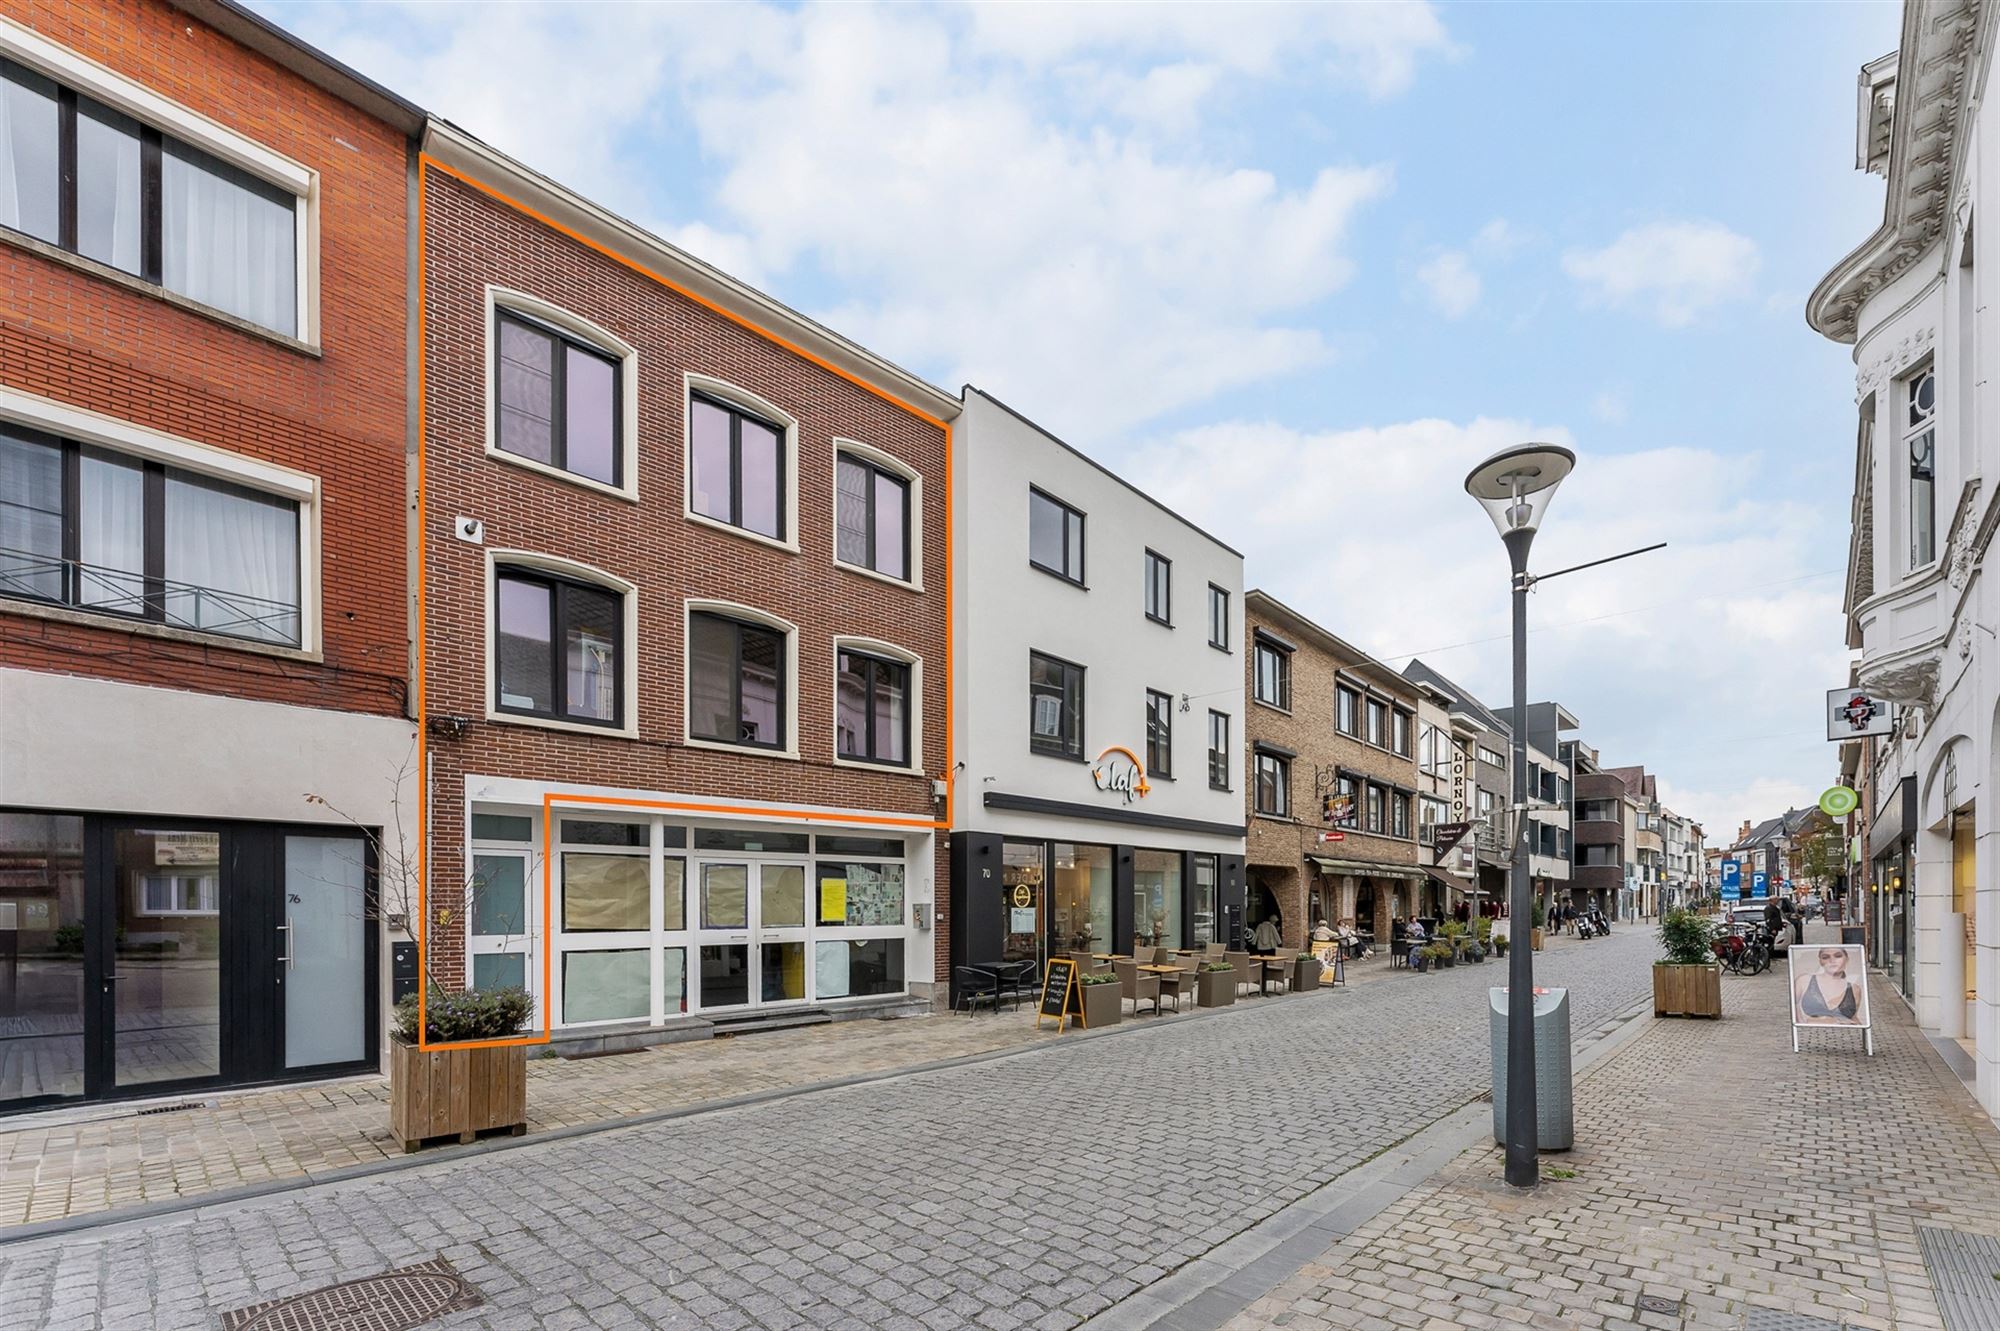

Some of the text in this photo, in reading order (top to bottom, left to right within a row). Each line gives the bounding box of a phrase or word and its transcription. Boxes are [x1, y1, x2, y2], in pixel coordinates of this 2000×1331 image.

[1453, 752, 1464, 822] LORNOY
[982, 867, 991, 879] 70
[1723, 863, 1738, 880] P
[1753, 875, 1764, 888] P
[287, 893, 302, 904] 76
